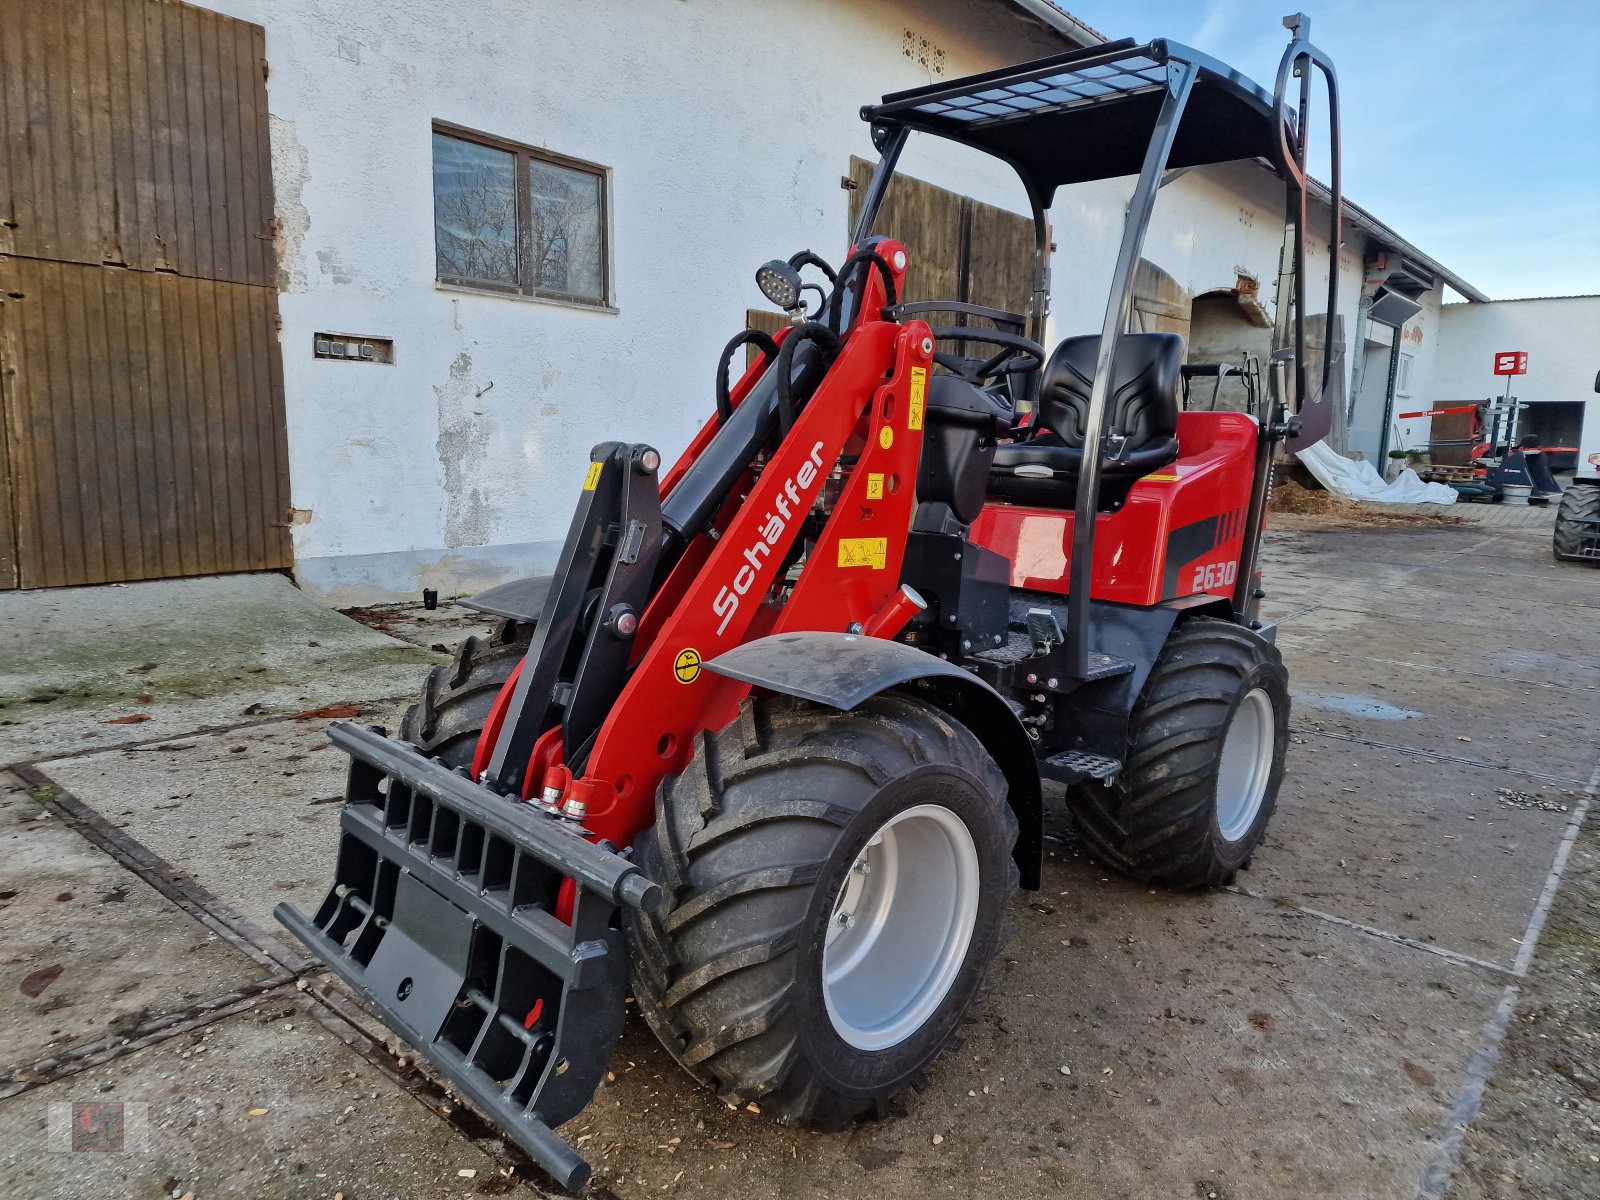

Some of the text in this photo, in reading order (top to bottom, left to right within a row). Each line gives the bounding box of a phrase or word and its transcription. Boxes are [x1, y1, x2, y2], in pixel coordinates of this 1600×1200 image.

[1499, 356, 1515, 370] S
[712, 440, 824, 636] Schäffer
[1192, 560, 1237, 592] 2630
